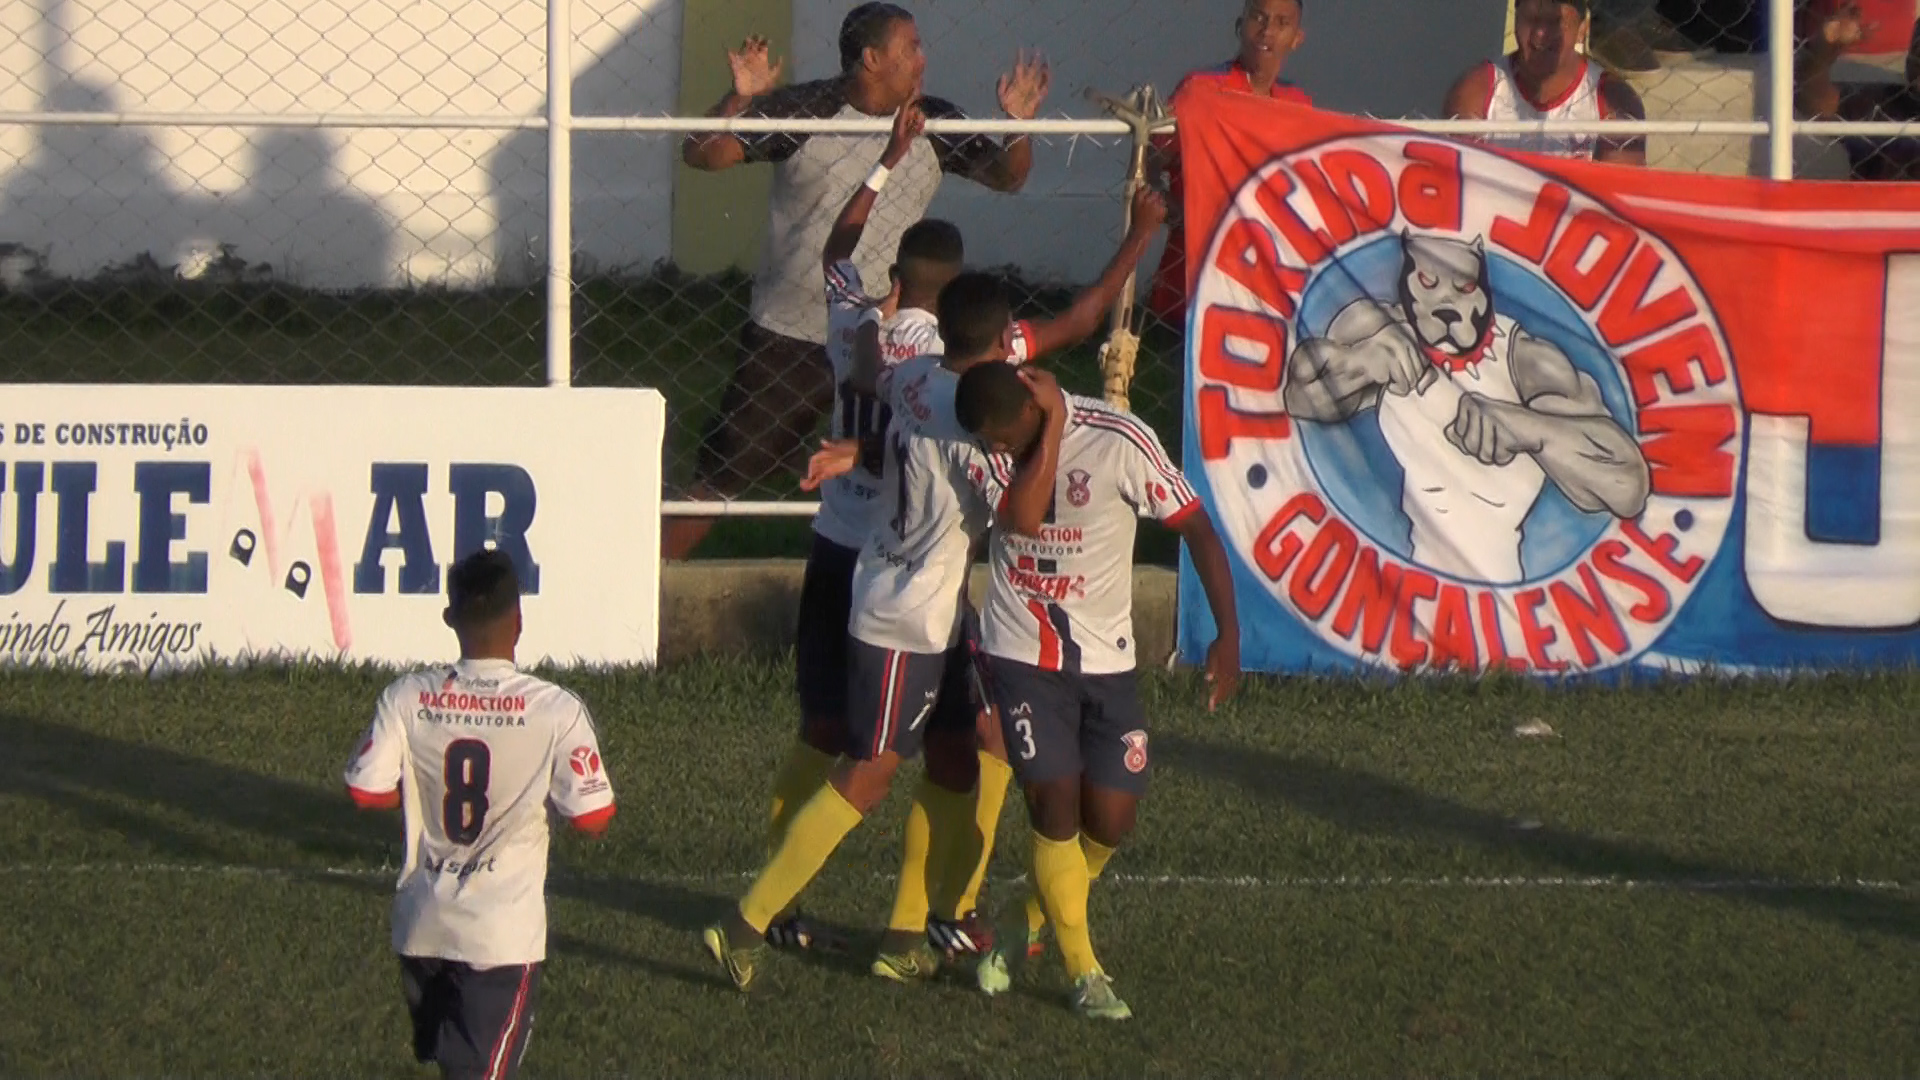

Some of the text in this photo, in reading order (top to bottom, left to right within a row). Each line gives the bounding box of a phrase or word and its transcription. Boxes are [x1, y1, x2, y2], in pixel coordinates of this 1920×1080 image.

[1489, 182, 1736, 499] JOVEM
[14, 423, 45, 444] DE
[55, 416, 209, 451] CONSTRUÇÃO
[74, 603, 202, 679] Amigos
[417, 708, 526, 727] CONSTRUTORA
[419, 691, 525, 712] MACROACTION
[1014, 718, 1037, 761] 3
[443, 738, 491, 846] 8
